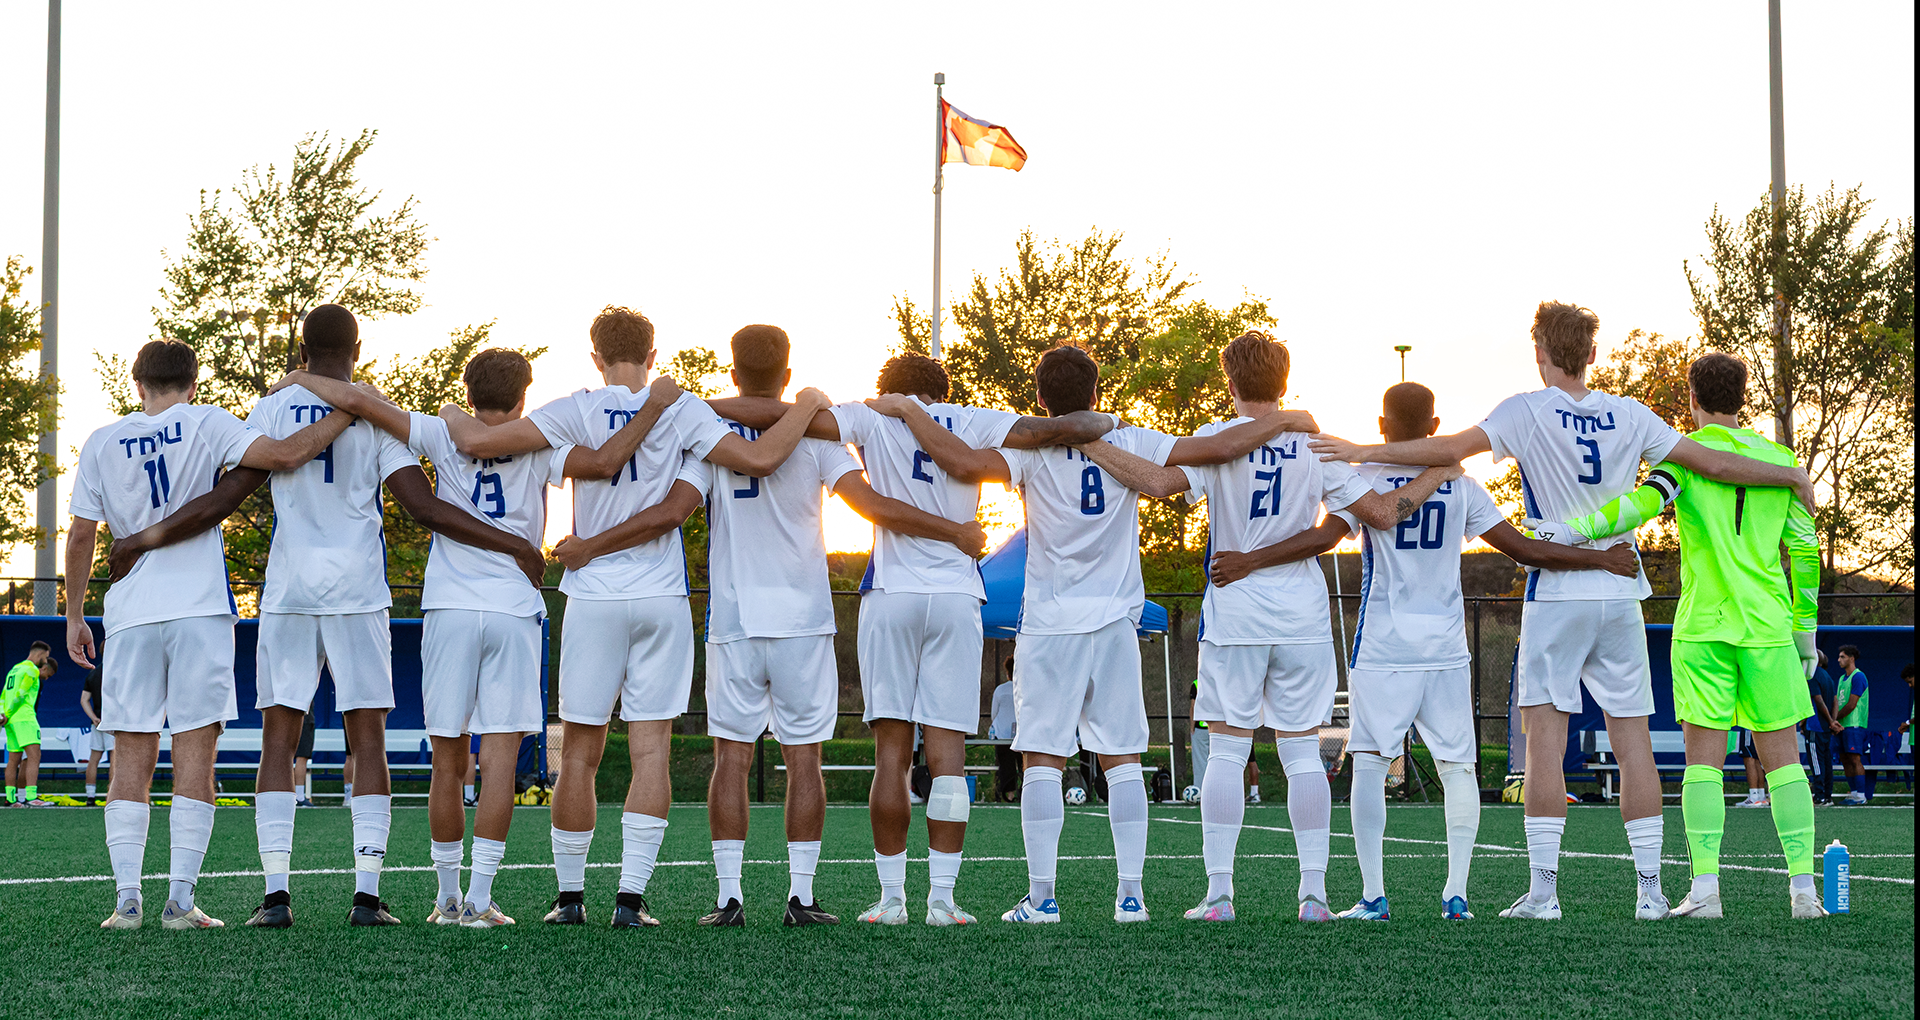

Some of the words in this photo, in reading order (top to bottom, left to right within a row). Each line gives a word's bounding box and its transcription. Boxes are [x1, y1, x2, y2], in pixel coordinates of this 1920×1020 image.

[290, 405, 356, 427] TM
[1555, 409, 1616, 434] TMU
[119, 422, 182, 459] TMU
[1576, 436, 1602, 485] 3
[144, 454, 170, 509] 11
[1080, 466, 1105, 515] 8
[1249, 467, 1282, 520] 21
[1395, 501, 1446, 549] 20
[1735, 487, 1746, 536] 1
[1837, 864, 1850, 910] CWENCH
